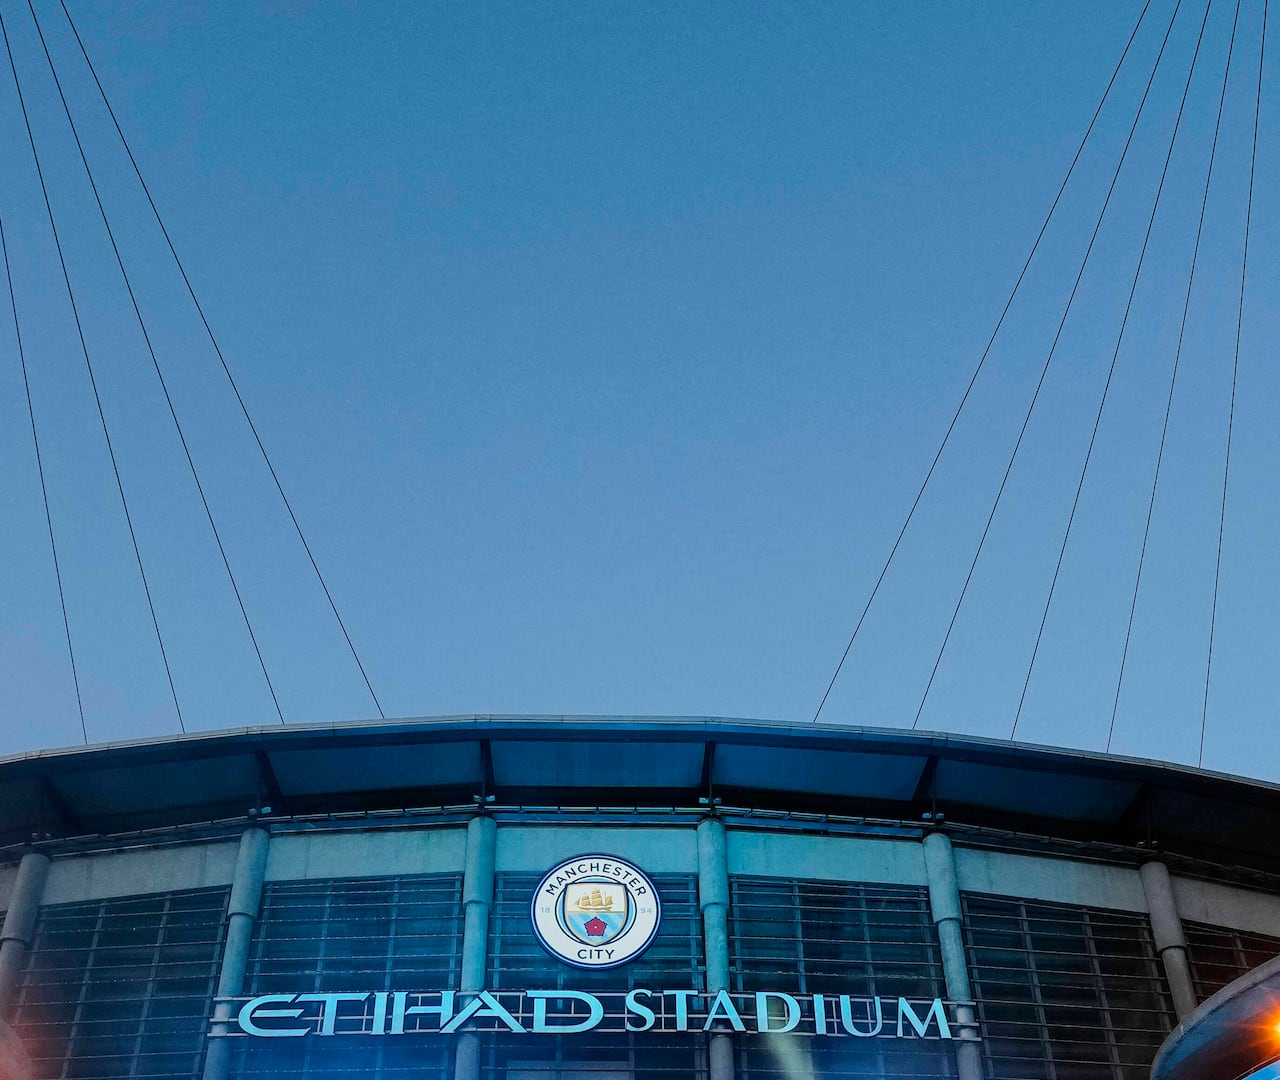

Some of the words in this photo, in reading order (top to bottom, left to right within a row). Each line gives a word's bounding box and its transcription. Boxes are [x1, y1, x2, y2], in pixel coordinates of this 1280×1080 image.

[546, 863, 647, 896] MANCHESTER
[577, 949, 614, 959] CITY
[237, 990, 604, 1038] ETIHAD
[624, 988, 952, 1038] STADIUM
